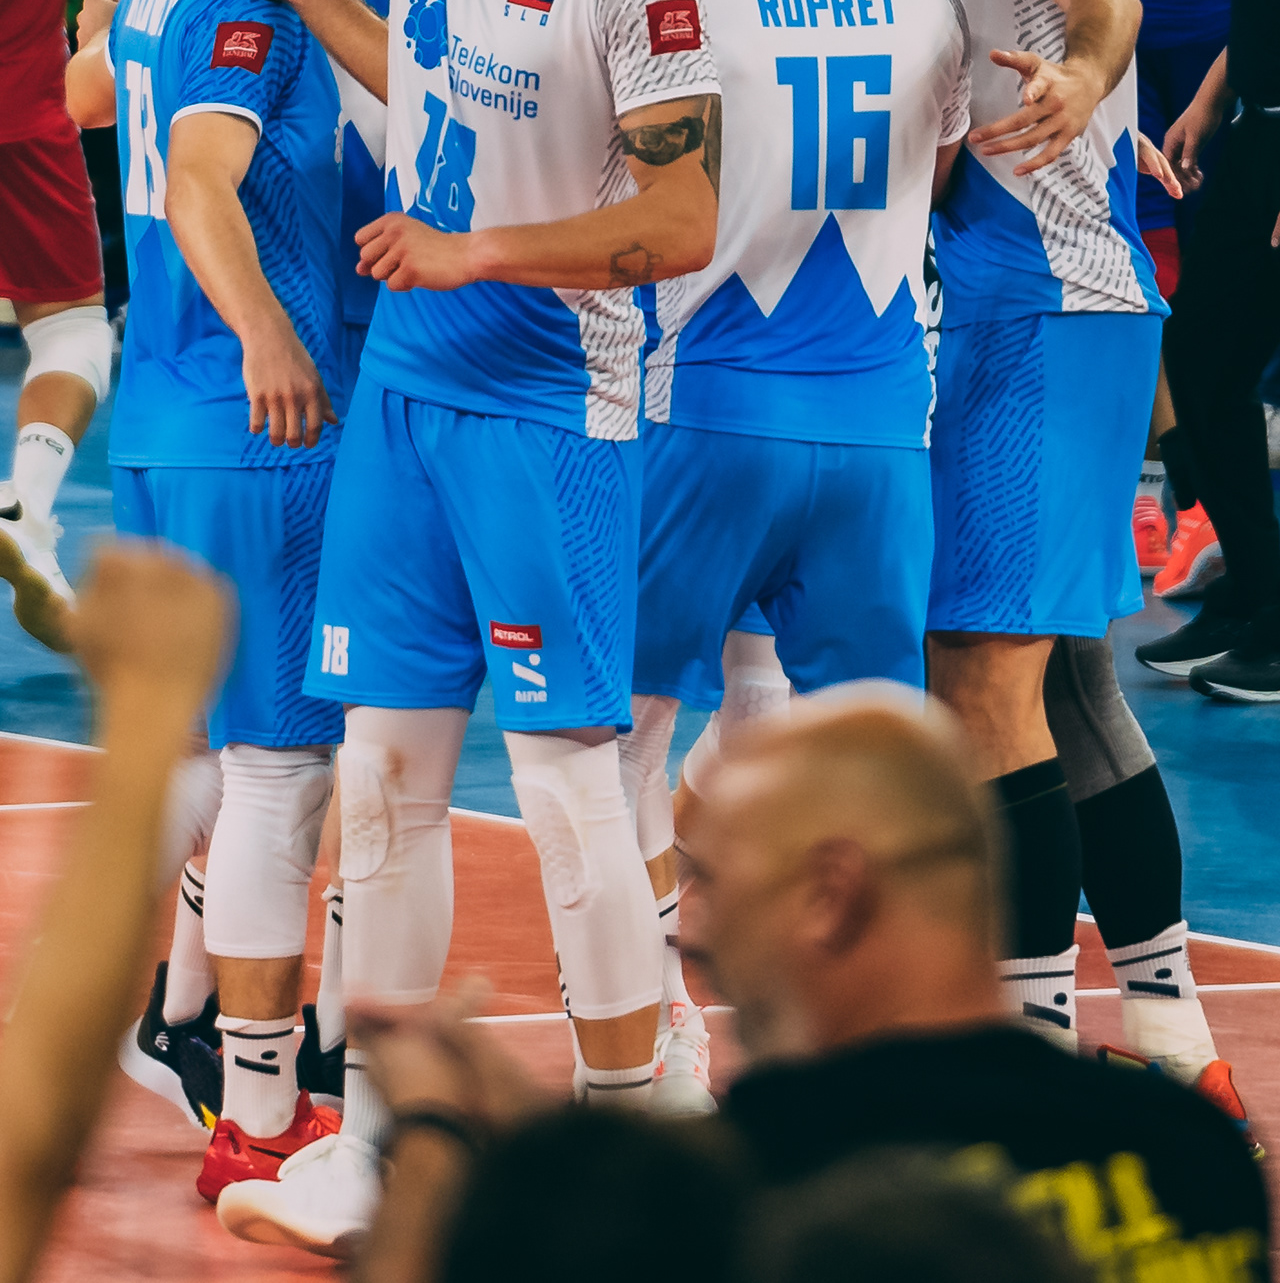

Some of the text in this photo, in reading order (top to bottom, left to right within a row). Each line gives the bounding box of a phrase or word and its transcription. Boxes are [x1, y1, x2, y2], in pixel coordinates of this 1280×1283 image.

[452, 34, 541, 92] Telekom
[449, 64, 539, 121] Slovenije
[415, 89, 477, 233] 18
[775, 54, 892, 211] 16
[322, 624, 349, 676] 18
